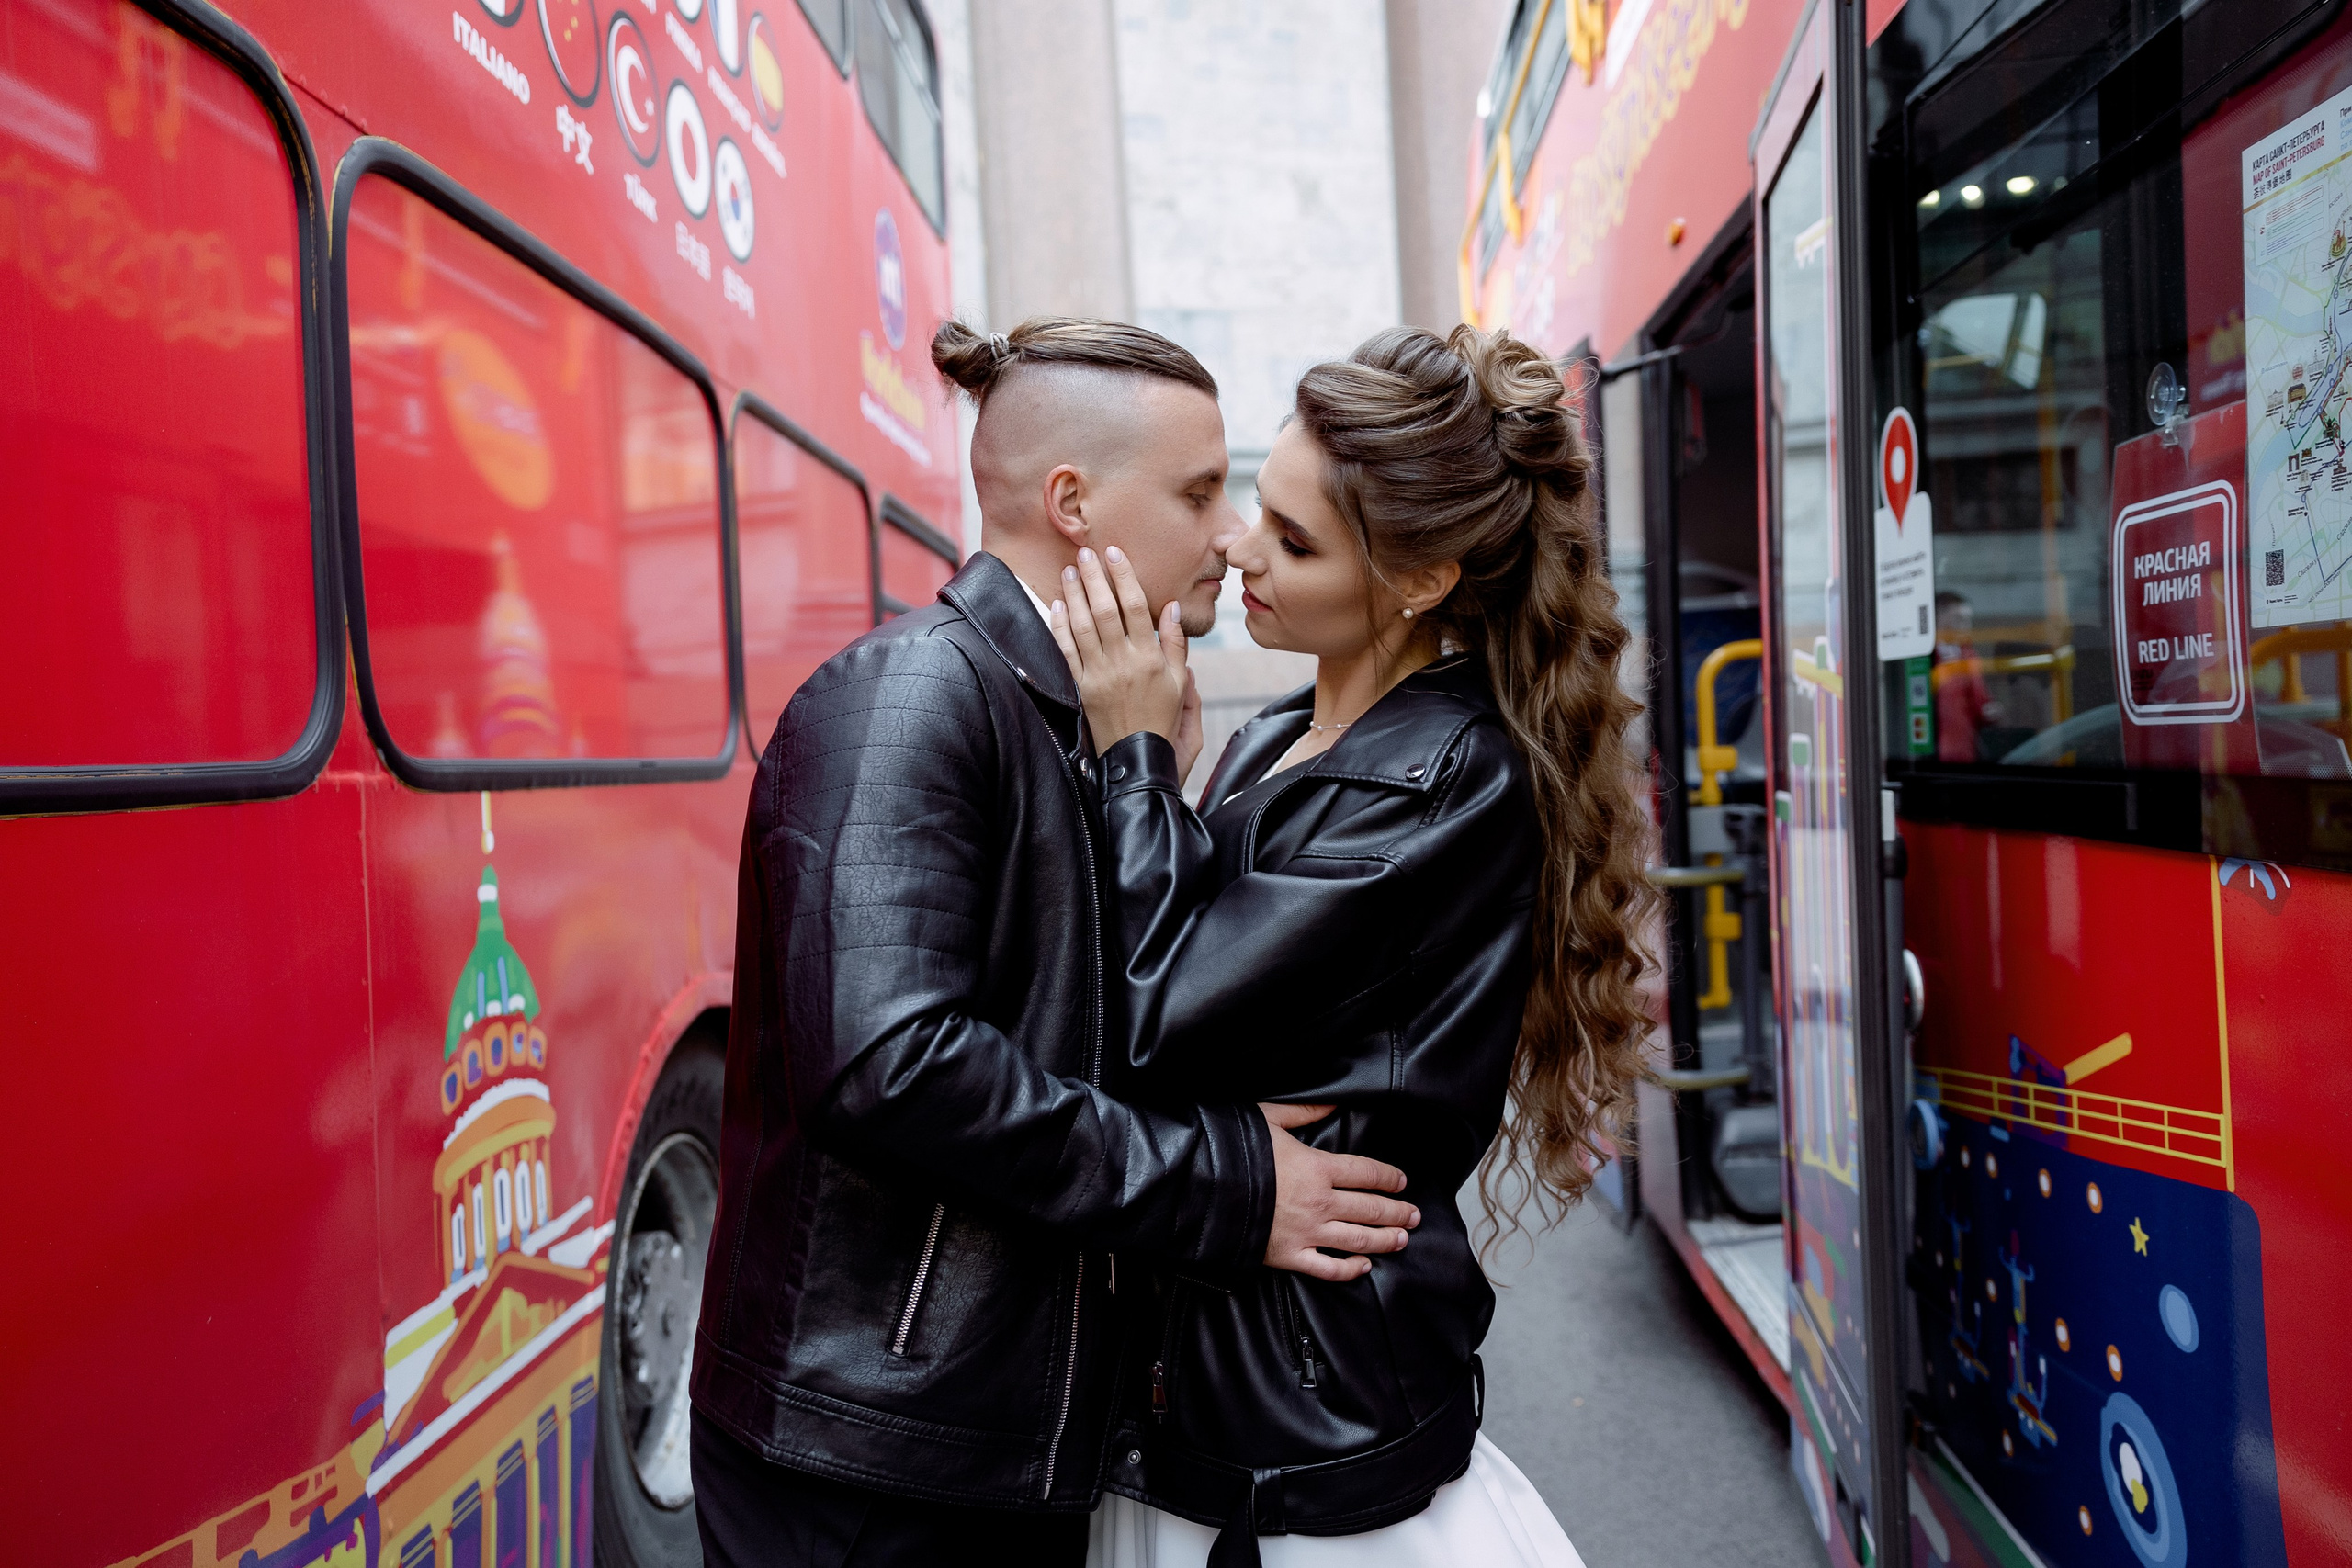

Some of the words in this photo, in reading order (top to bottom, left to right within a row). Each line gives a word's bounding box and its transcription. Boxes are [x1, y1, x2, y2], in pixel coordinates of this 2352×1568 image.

[452, 10, 531, 106] ITALIANO
[555, 103, 594, 175] 中文
[2252, 153, 2269, 172] КАРТА
[2269, 120, 2325, 162] САНКТ-ПЕТЕРБУРГА
[2253, 170, 2265, 186] MAP
[2265, 165, 2272, 178] OF
[2272, 135, 2325, 175] SAINT-PETERSBURG
[2133, 540, 2211, 579] КРАСНАЯ
[2142, 572, 2202, 607] ЛИНИЯ
[2138, 636, 2170, 664] RED
[2174, 632, 2215, 660] LINE
